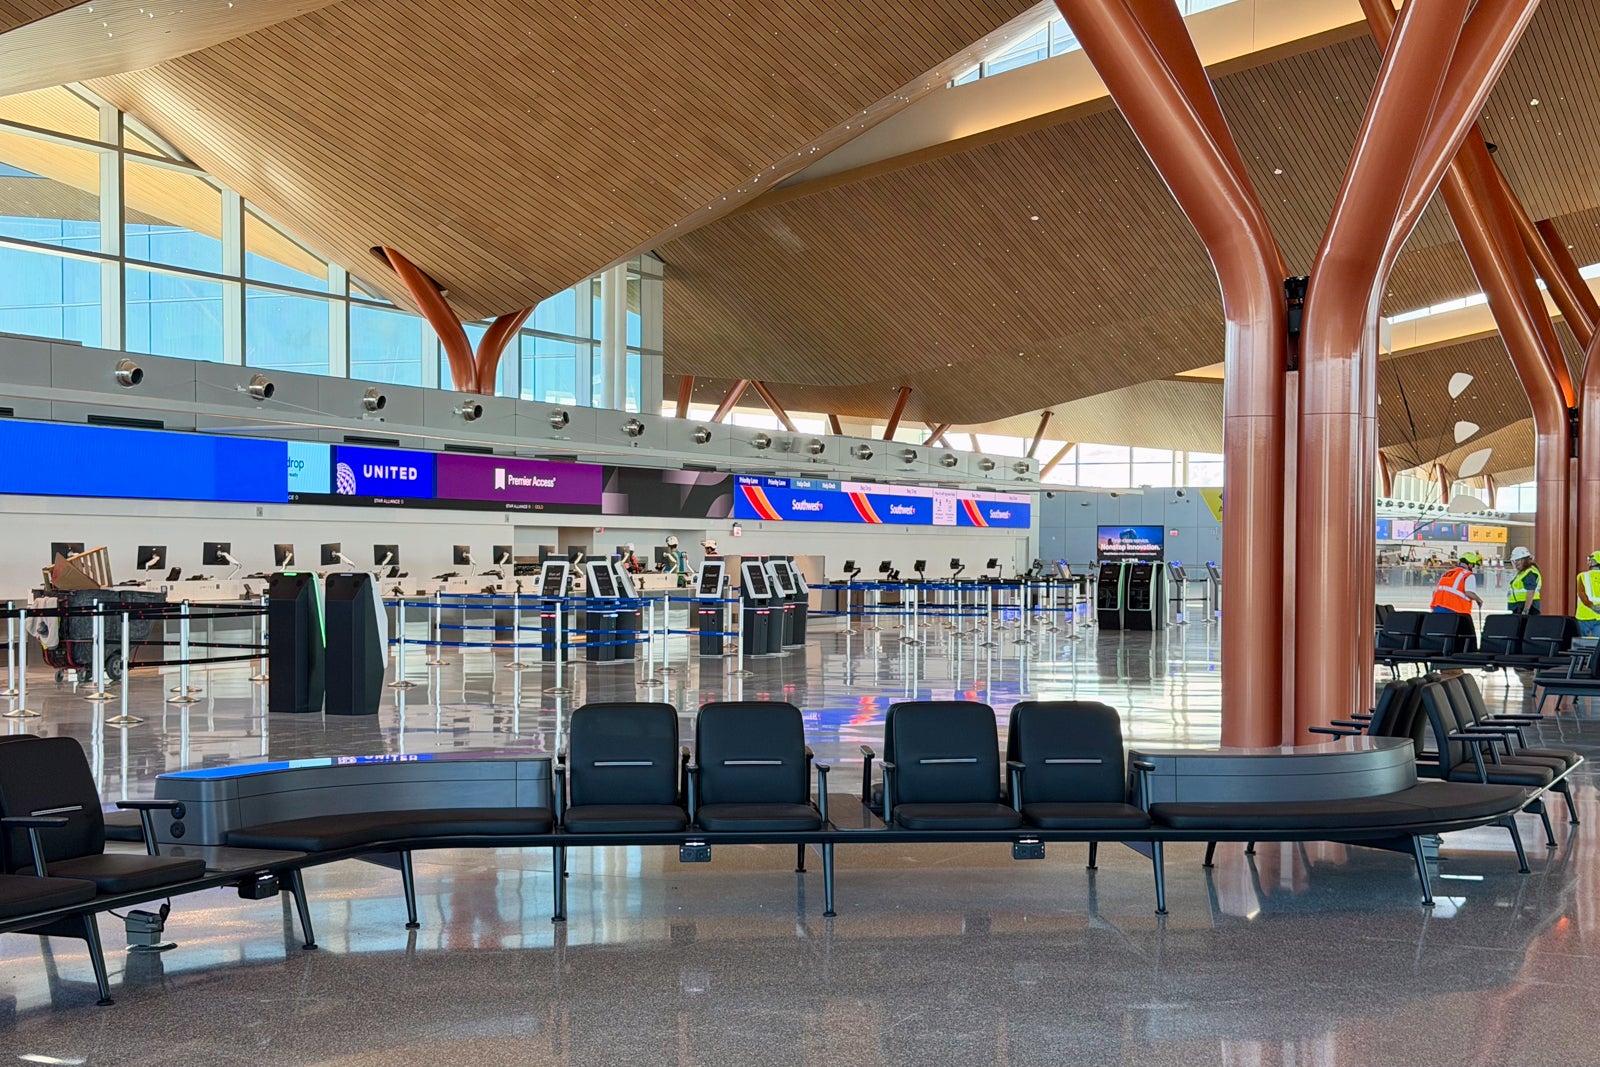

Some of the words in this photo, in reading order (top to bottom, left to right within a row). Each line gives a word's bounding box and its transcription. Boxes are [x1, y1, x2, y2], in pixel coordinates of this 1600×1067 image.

[363, 465, 417, 480] UNITED
[508, 475, 532, 486] Premier
[739, 476, 751, 485] Priority
[768, 478, 778, 486] Priority
[792, 499, 820, 511] Southwest
[890, 504, 914, 515] Southwest
